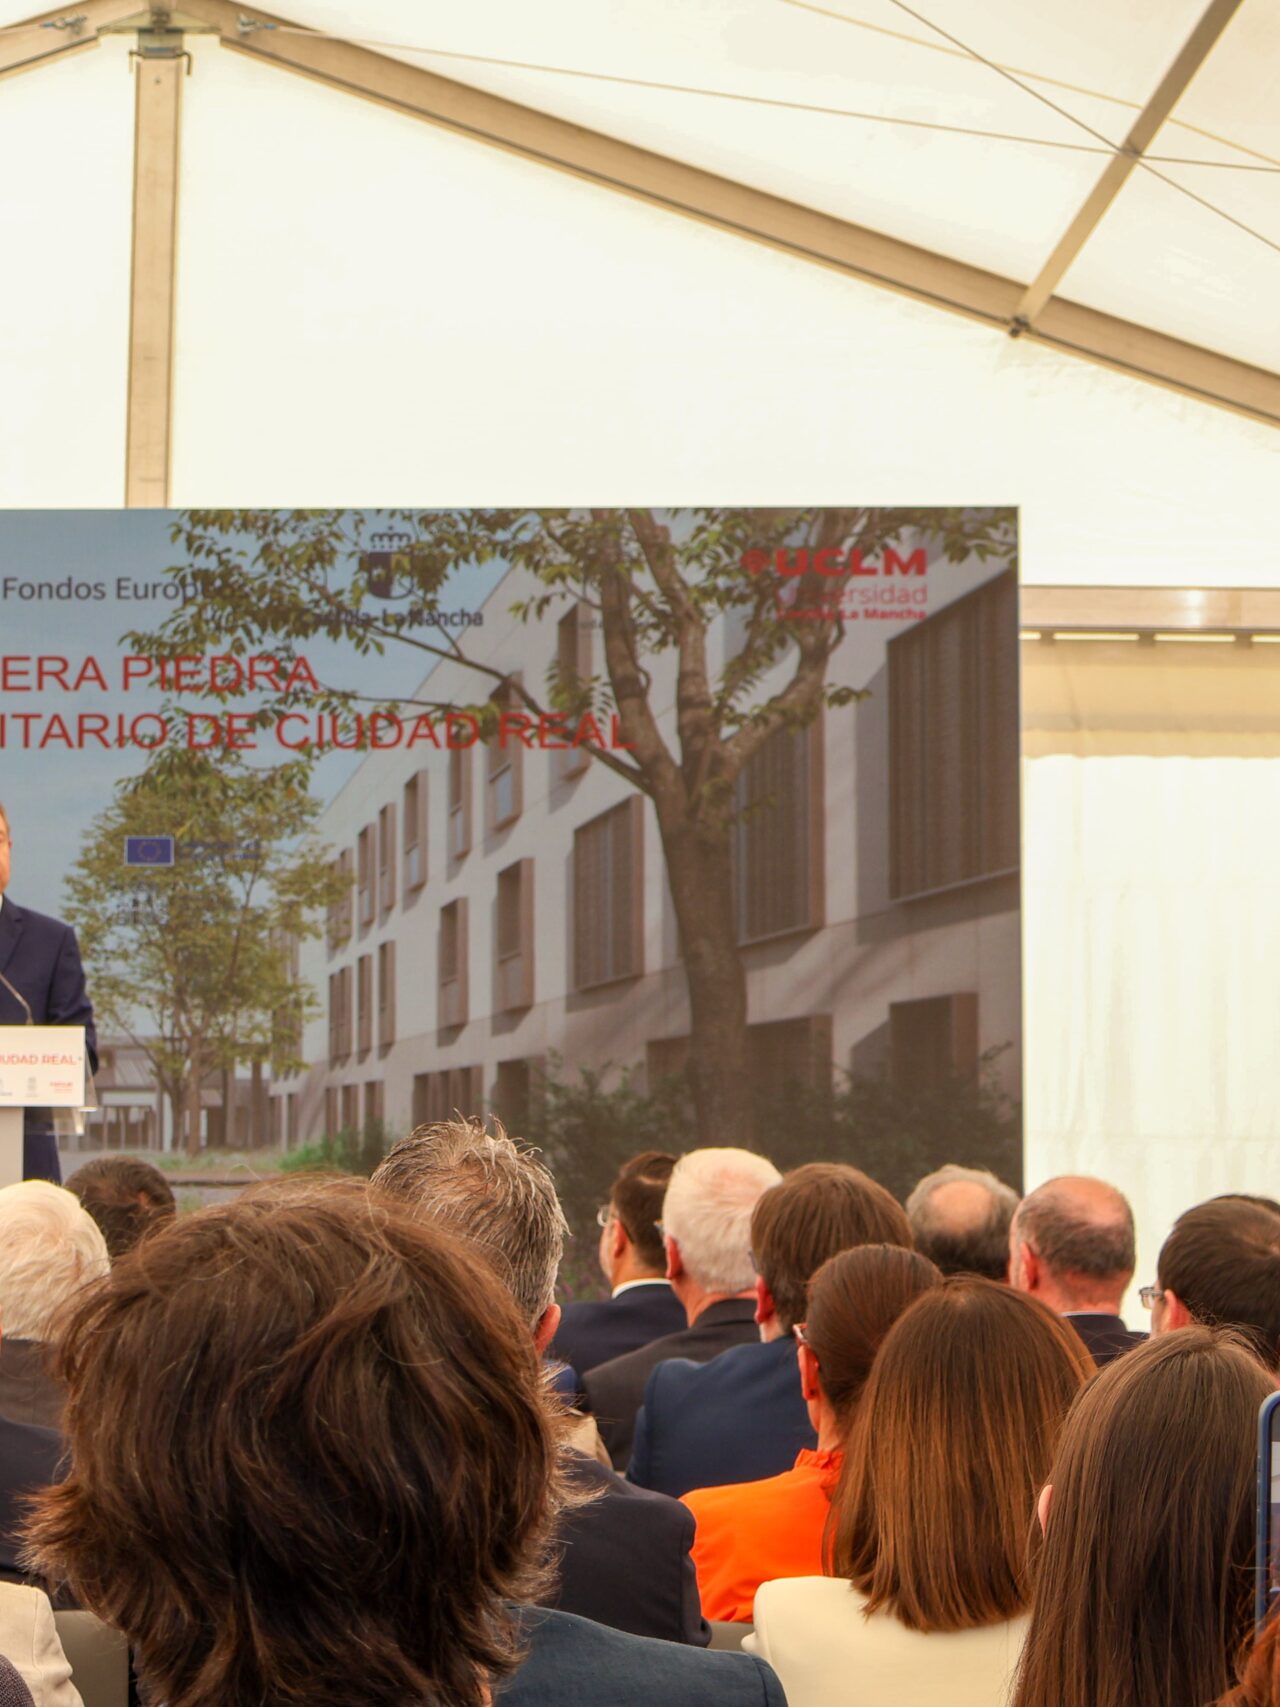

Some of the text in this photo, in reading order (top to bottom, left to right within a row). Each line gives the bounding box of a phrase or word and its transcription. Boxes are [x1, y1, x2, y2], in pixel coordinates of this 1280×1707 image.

[775, 547, 928, 577] UCLM
[2, 576, 107, 601] Fondos
[122, 655, 320, 692] PIEDRA
[186, 713, 258, 749] DE
[275, 712, 480, 750] CIUDAD
[499, 713, 639, 750] REAL
[42, 1053, 77, 1066] REAL
